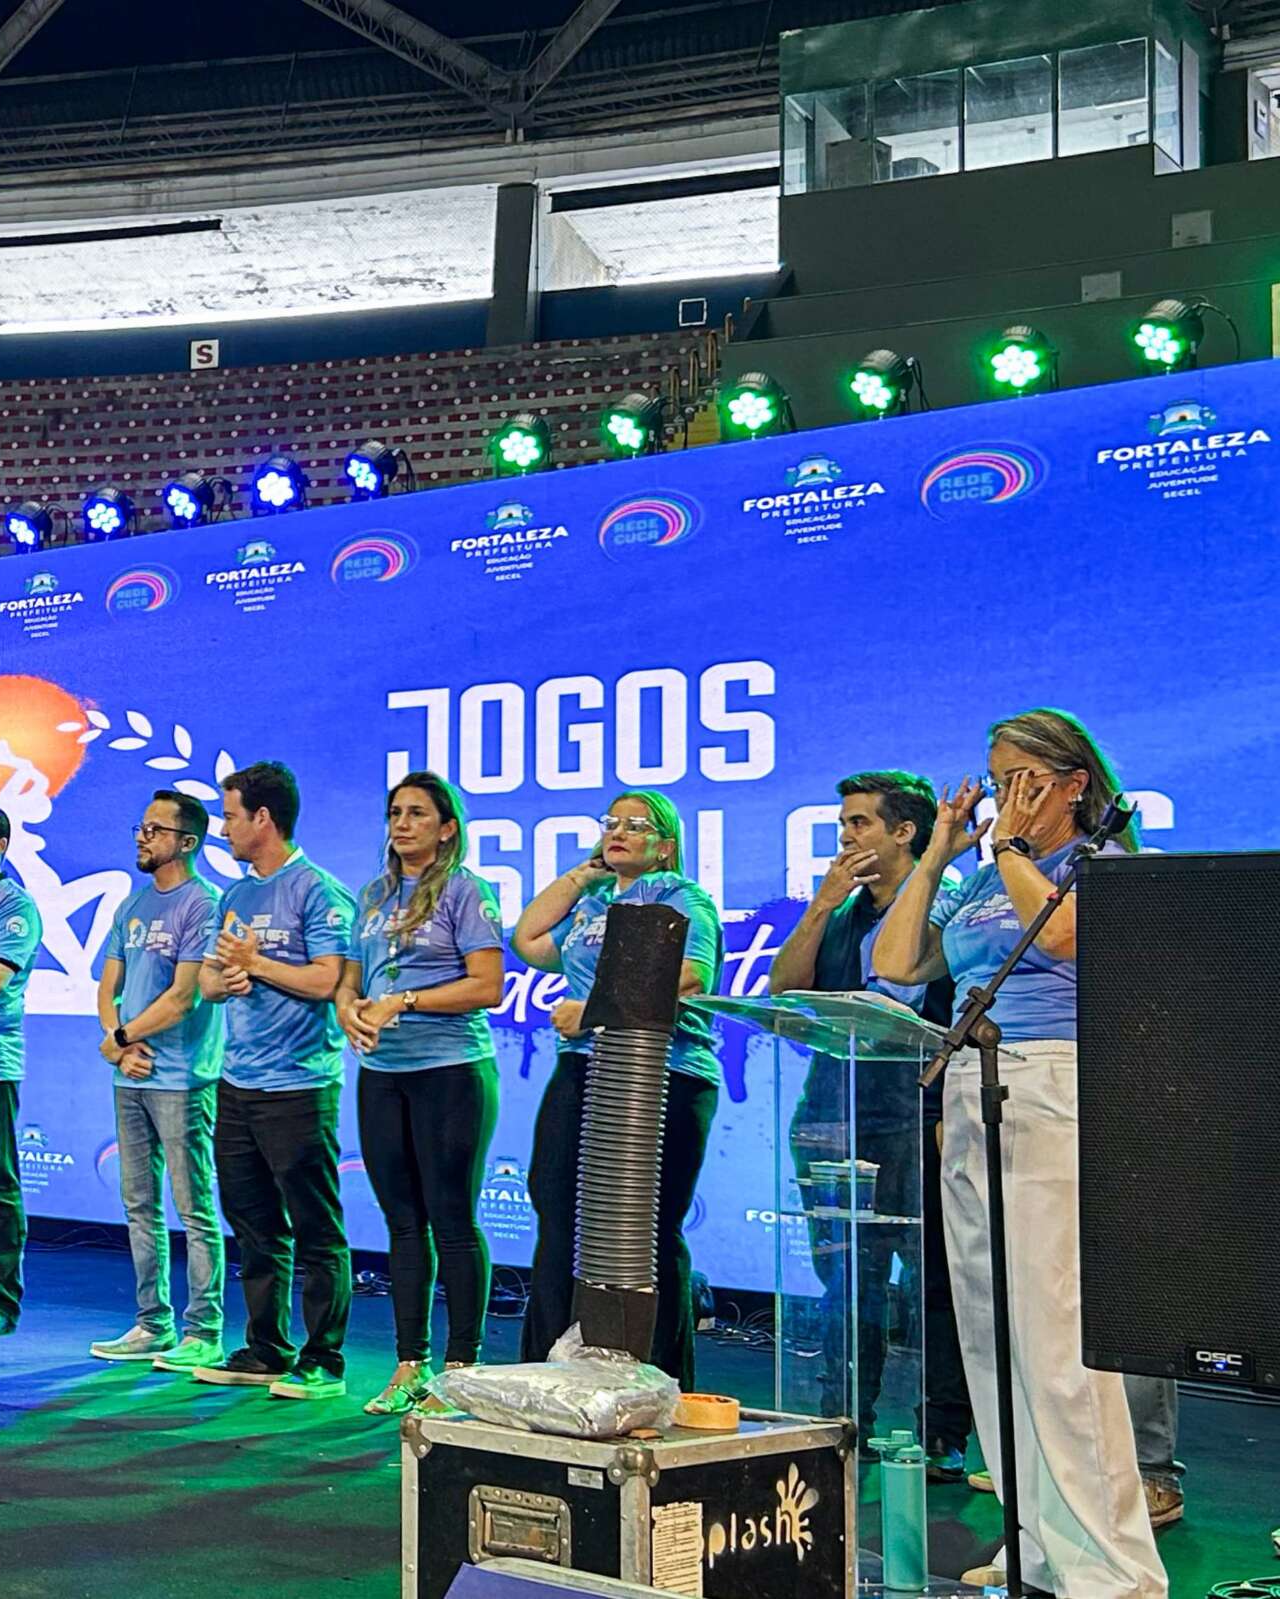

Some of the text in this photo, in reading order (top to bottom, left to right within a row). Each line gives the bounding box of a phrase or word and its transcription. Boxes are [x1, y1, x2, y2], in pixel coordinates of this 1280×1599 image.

[196, 345, 213, 364] S
[1097, 430, 1271, 464] FORTALEZA
[1119, 449, 1247, 472] PREFEITURA
[1149, 464, 1216, 479] EDUCAÇÃO
[940, 472, 993, 490] REDE
[1147, 474, 1218, 490] JUVENTUDE
[743, 482, 886, 512] FORTALEZA
[940, 486, 993, 503] CUCA
[1163, 488, 1201, 499] SECEL
[761, 499, 866, 519] PREFEITURA
[613, 518, 659, 533] REDE
[784, 523, 843, 536] JUVENTUDE
[451, 526, 569, 552] FORTALEZA
[613, 531, 660, 545] CUCA
[797, 534, 829, 544] SECEL
[465, 541, 553, 559] PREFEITURA
[344, 556, 382, 569] REDE
[206, 562, 306, 585] FORTALEZA
[344, 568, 383, 581] CUCA
[495, 573, 522, 582] SECEL
[218, 576, 293, 590] PREFEITURA
[0, 592, 85, 613] FORTALEZA
[10, 605, 73, 619] PREFEITURA
[387, 661, 777, 795] JOGOS
[18, 1150, 75, 1167] TALEZA
[1196, 1351, 1242, 1366] QSC
[706, 1506, 792, 1569] plash
